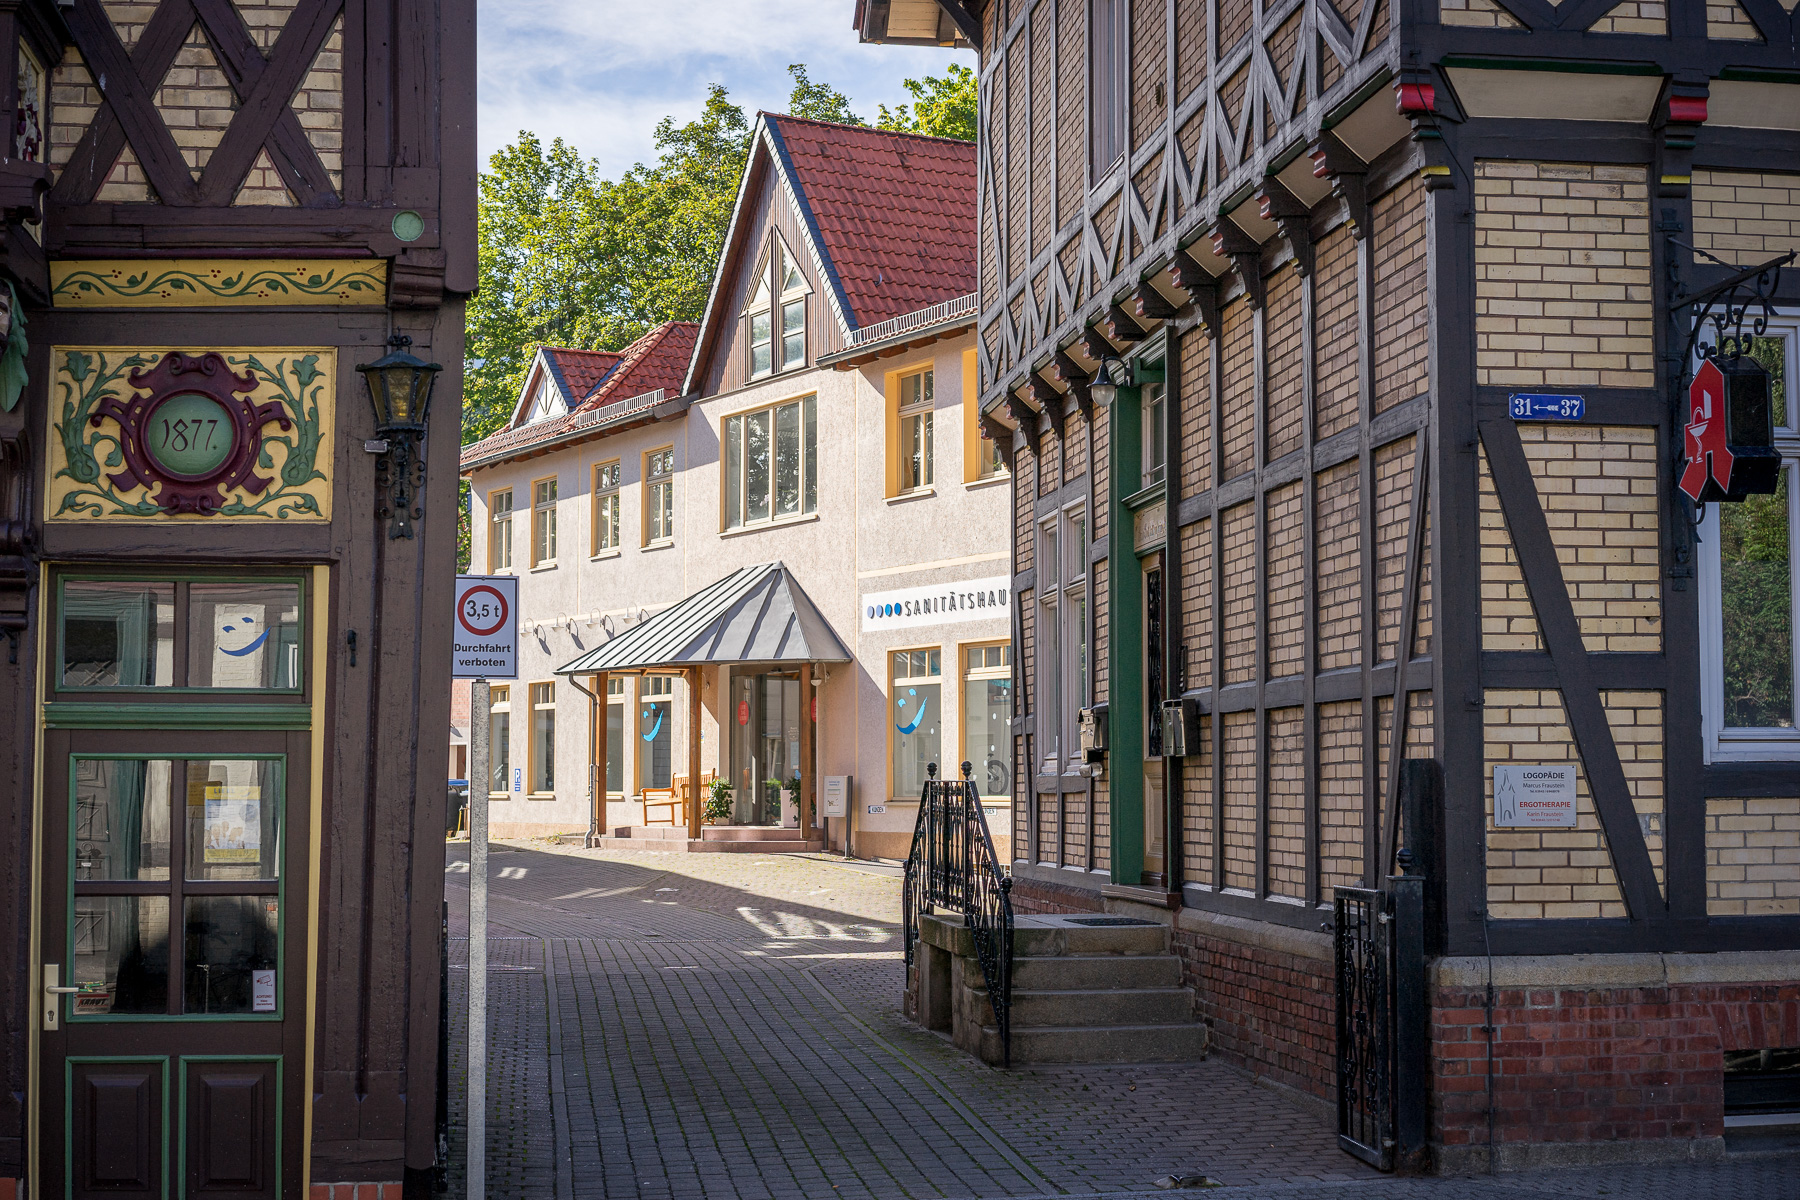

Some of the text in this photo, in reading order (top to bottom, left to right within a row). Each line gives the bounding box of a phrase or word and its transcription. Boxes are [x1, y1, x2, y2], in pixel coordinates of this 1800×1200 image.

[1514, 398, 1580, 417] 31 37
[904, 588, 1011, 617] SANITÄTSHAU
[466, 600, 500, 620] 3,5 t
[454, 644, 511, 653] Durchfahrt
[459, 658, 506, 667] verboten
[1523, 771, 1565, 779] LOGOPÄDIE
